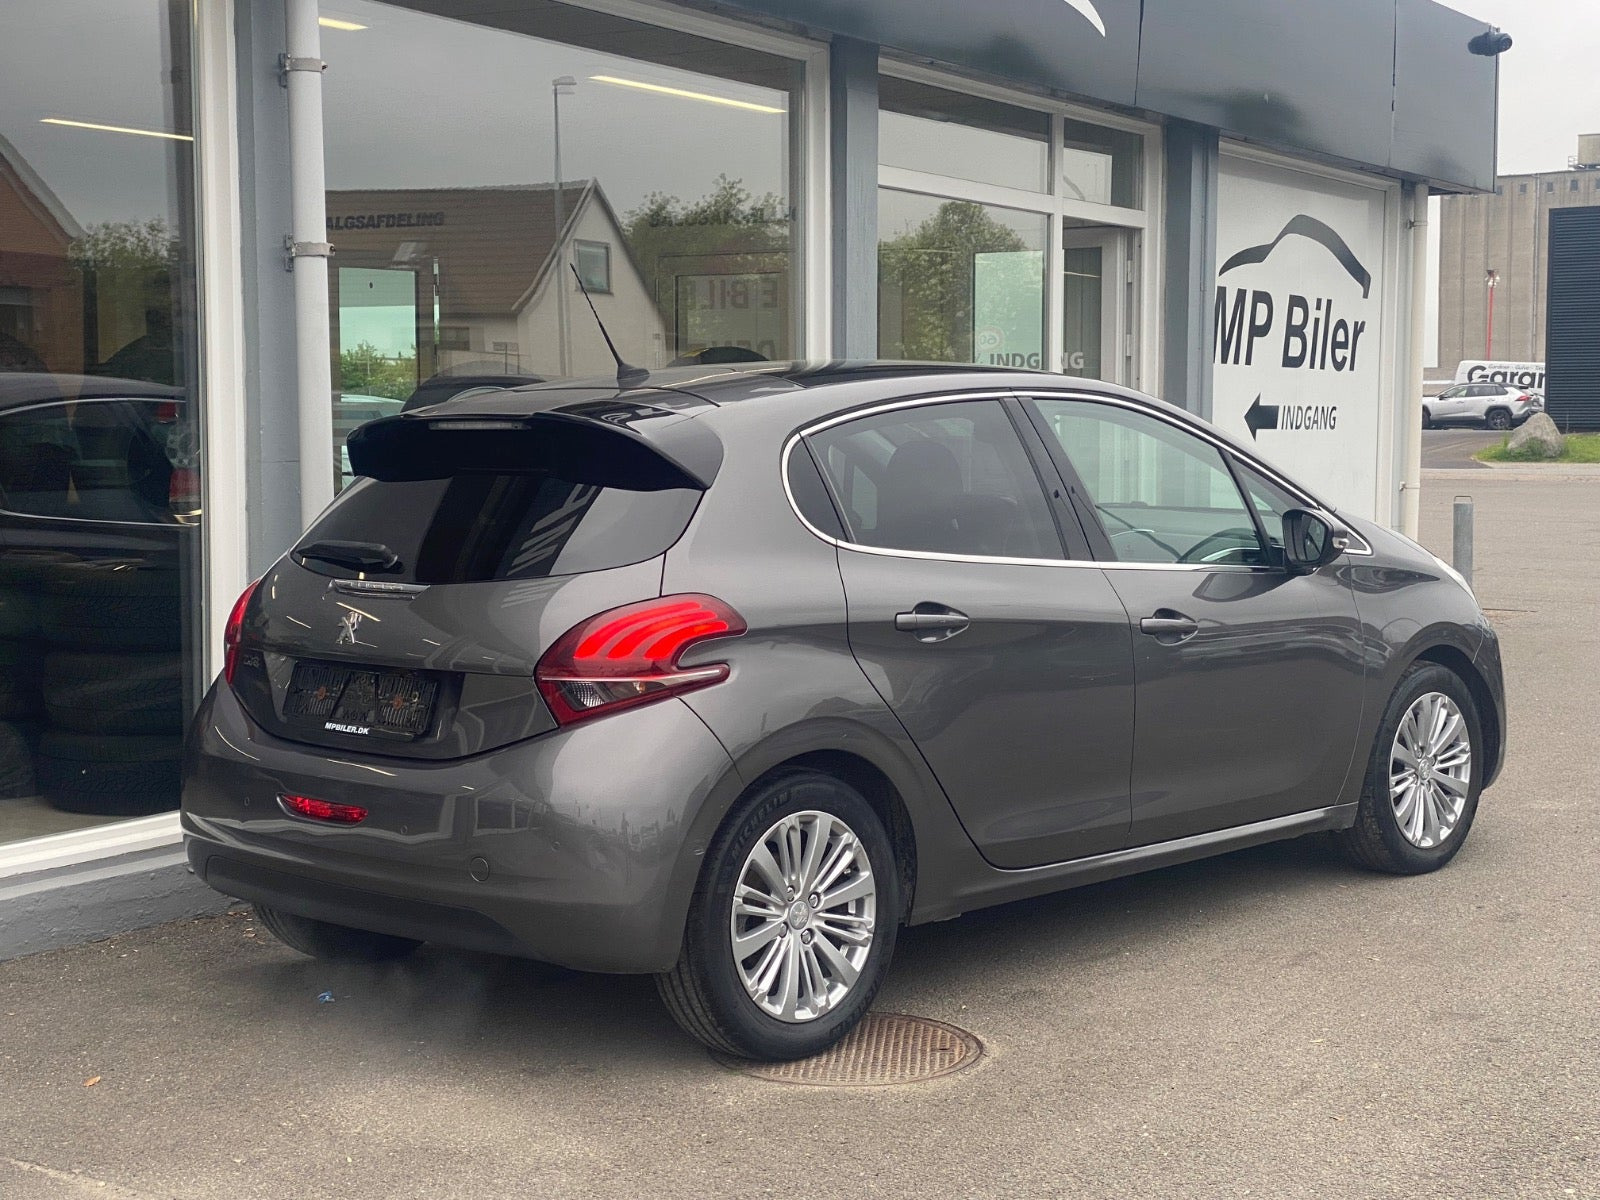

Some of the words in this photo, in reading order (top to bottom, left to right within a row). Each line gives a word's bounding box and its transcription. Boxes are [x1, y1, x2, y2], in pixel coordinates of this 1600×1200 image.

[326, 212, 444, 230] ALGSAFDELING
[1213, 286, 1274, 366] MP
[1282, 294, 1366, 372] Biler
[990, 352, 1085, 370] INDGNG
[1281, 405, 1337, 430] INDGANG
[324, 722, 370, 735] MPBILER.DK
